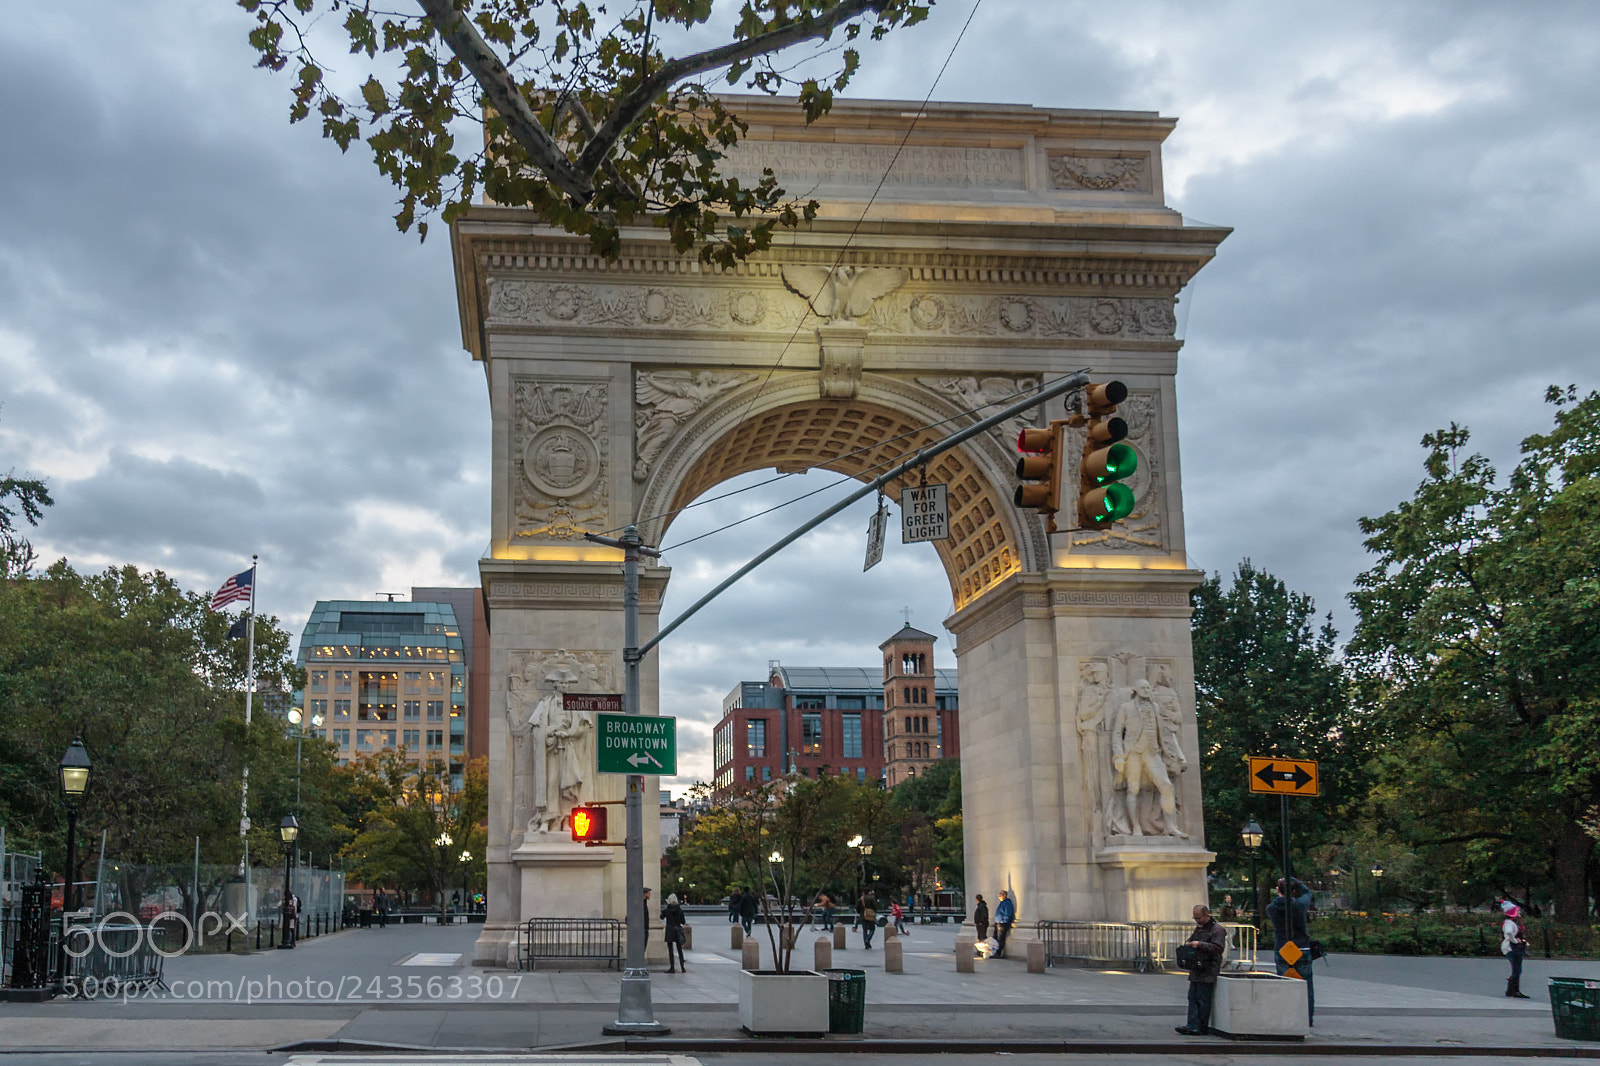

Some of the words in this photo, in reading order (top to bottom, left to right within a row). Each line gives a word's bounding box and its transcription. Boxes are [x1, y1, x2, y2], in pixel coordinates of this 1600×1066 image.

[824, 157, 843, 168] OF
[816, 170, 836, 181] OF
[911, 488, 937, 501] WAIT
[914, 501, 936, 513] FOR
[906, 513, 944, 527] GREEN
[909, 525, 942, 539] LIGHT
[566, 700, 594, 710] SQUARE
[597, 701, 619, 711] NORTH
[606, 721, 666, 735] BROADWAY
[606, 736, 668, 750] DOWNTOWN
